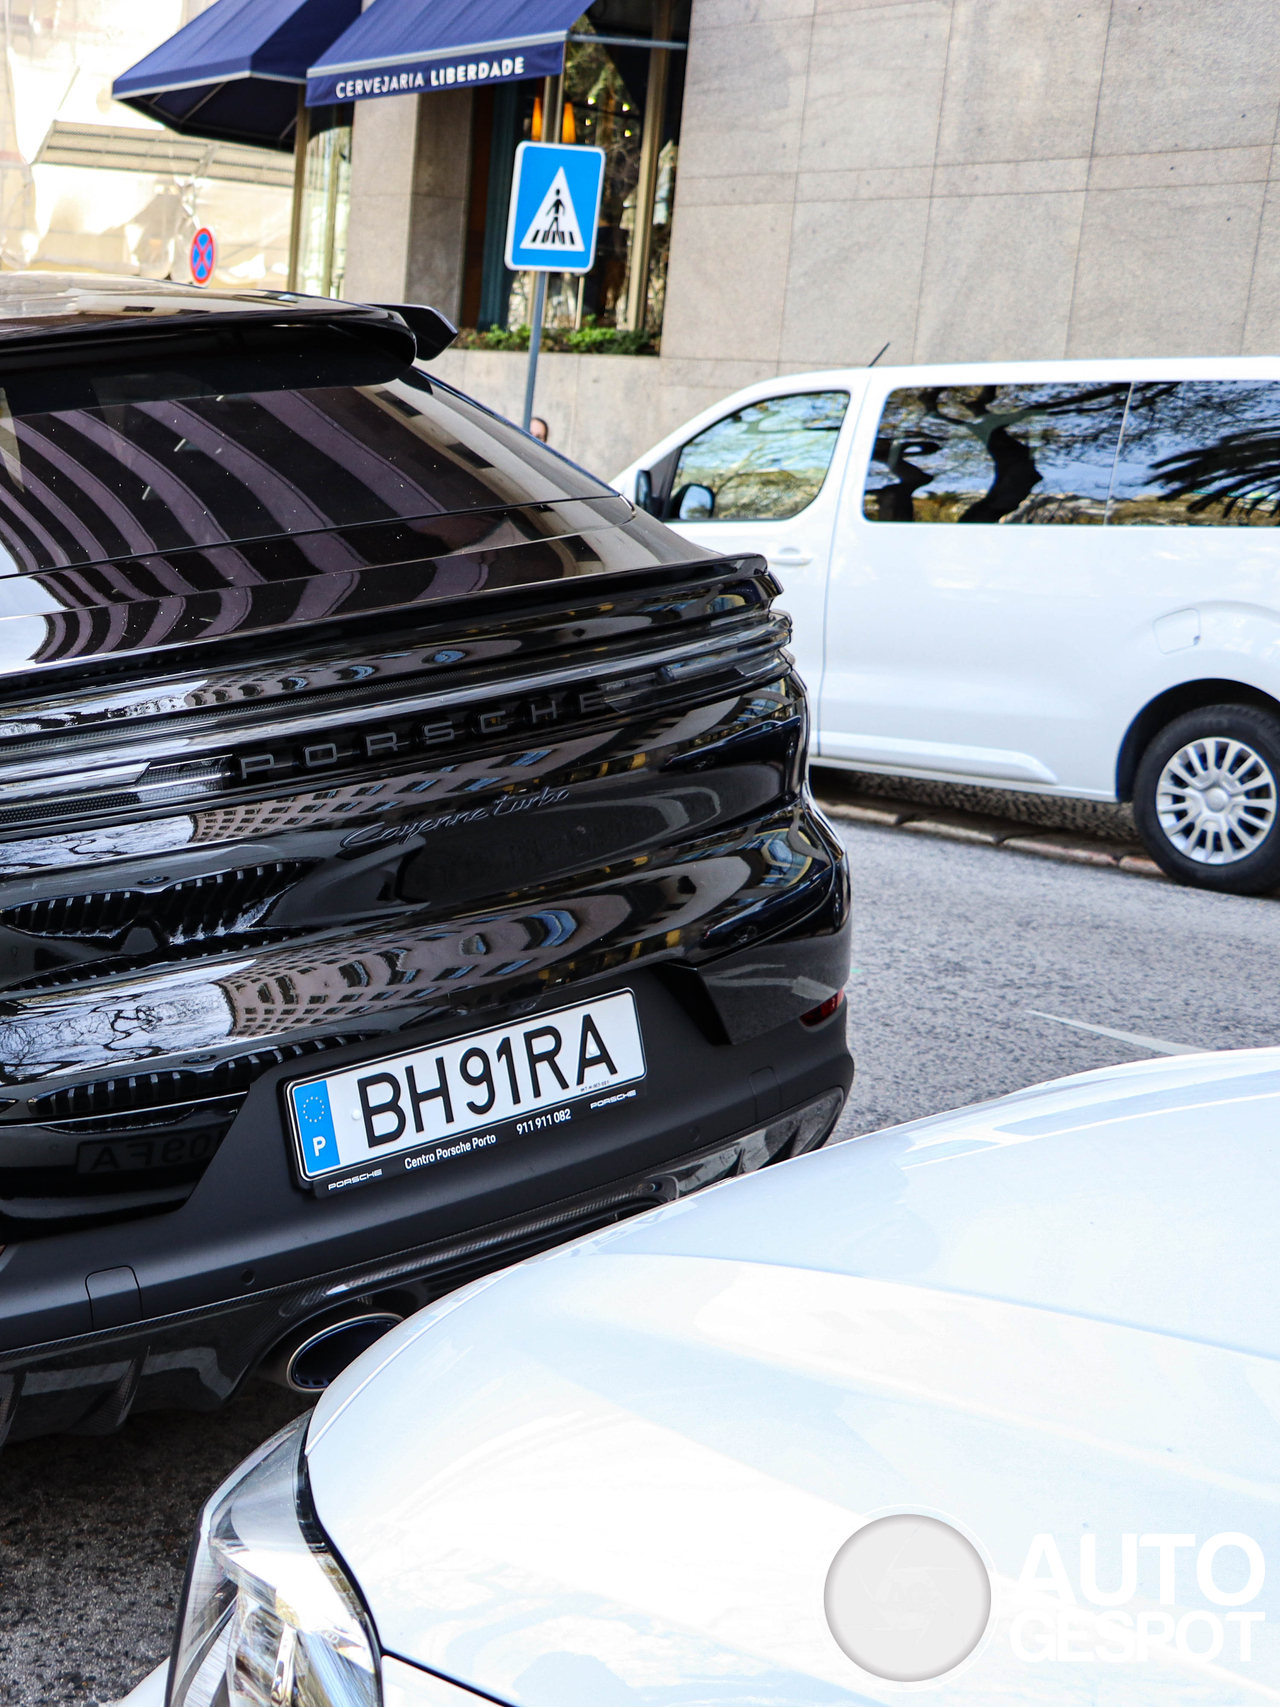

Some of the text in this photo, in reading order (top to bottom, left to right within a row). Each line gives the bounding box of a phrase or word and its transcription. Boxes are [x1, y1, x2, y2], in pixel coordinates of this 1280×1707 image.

[335, 56, 525, 99] CERVEJARIA LIBERDADE
[239, 690, 606, 780] PORSCHE
[340, 786, 570, 848] Cayenne turbo
[357, 1013, 618, 1149] BH91RA
[590, 1089, 637, 1110] PORSCHE
[312, 1136, 327, 1157] P
[404, 1108, 571, 1170] Centro Porsche Porto 911 911 082
[328, 1168, 383, 1191] PORSCHE
